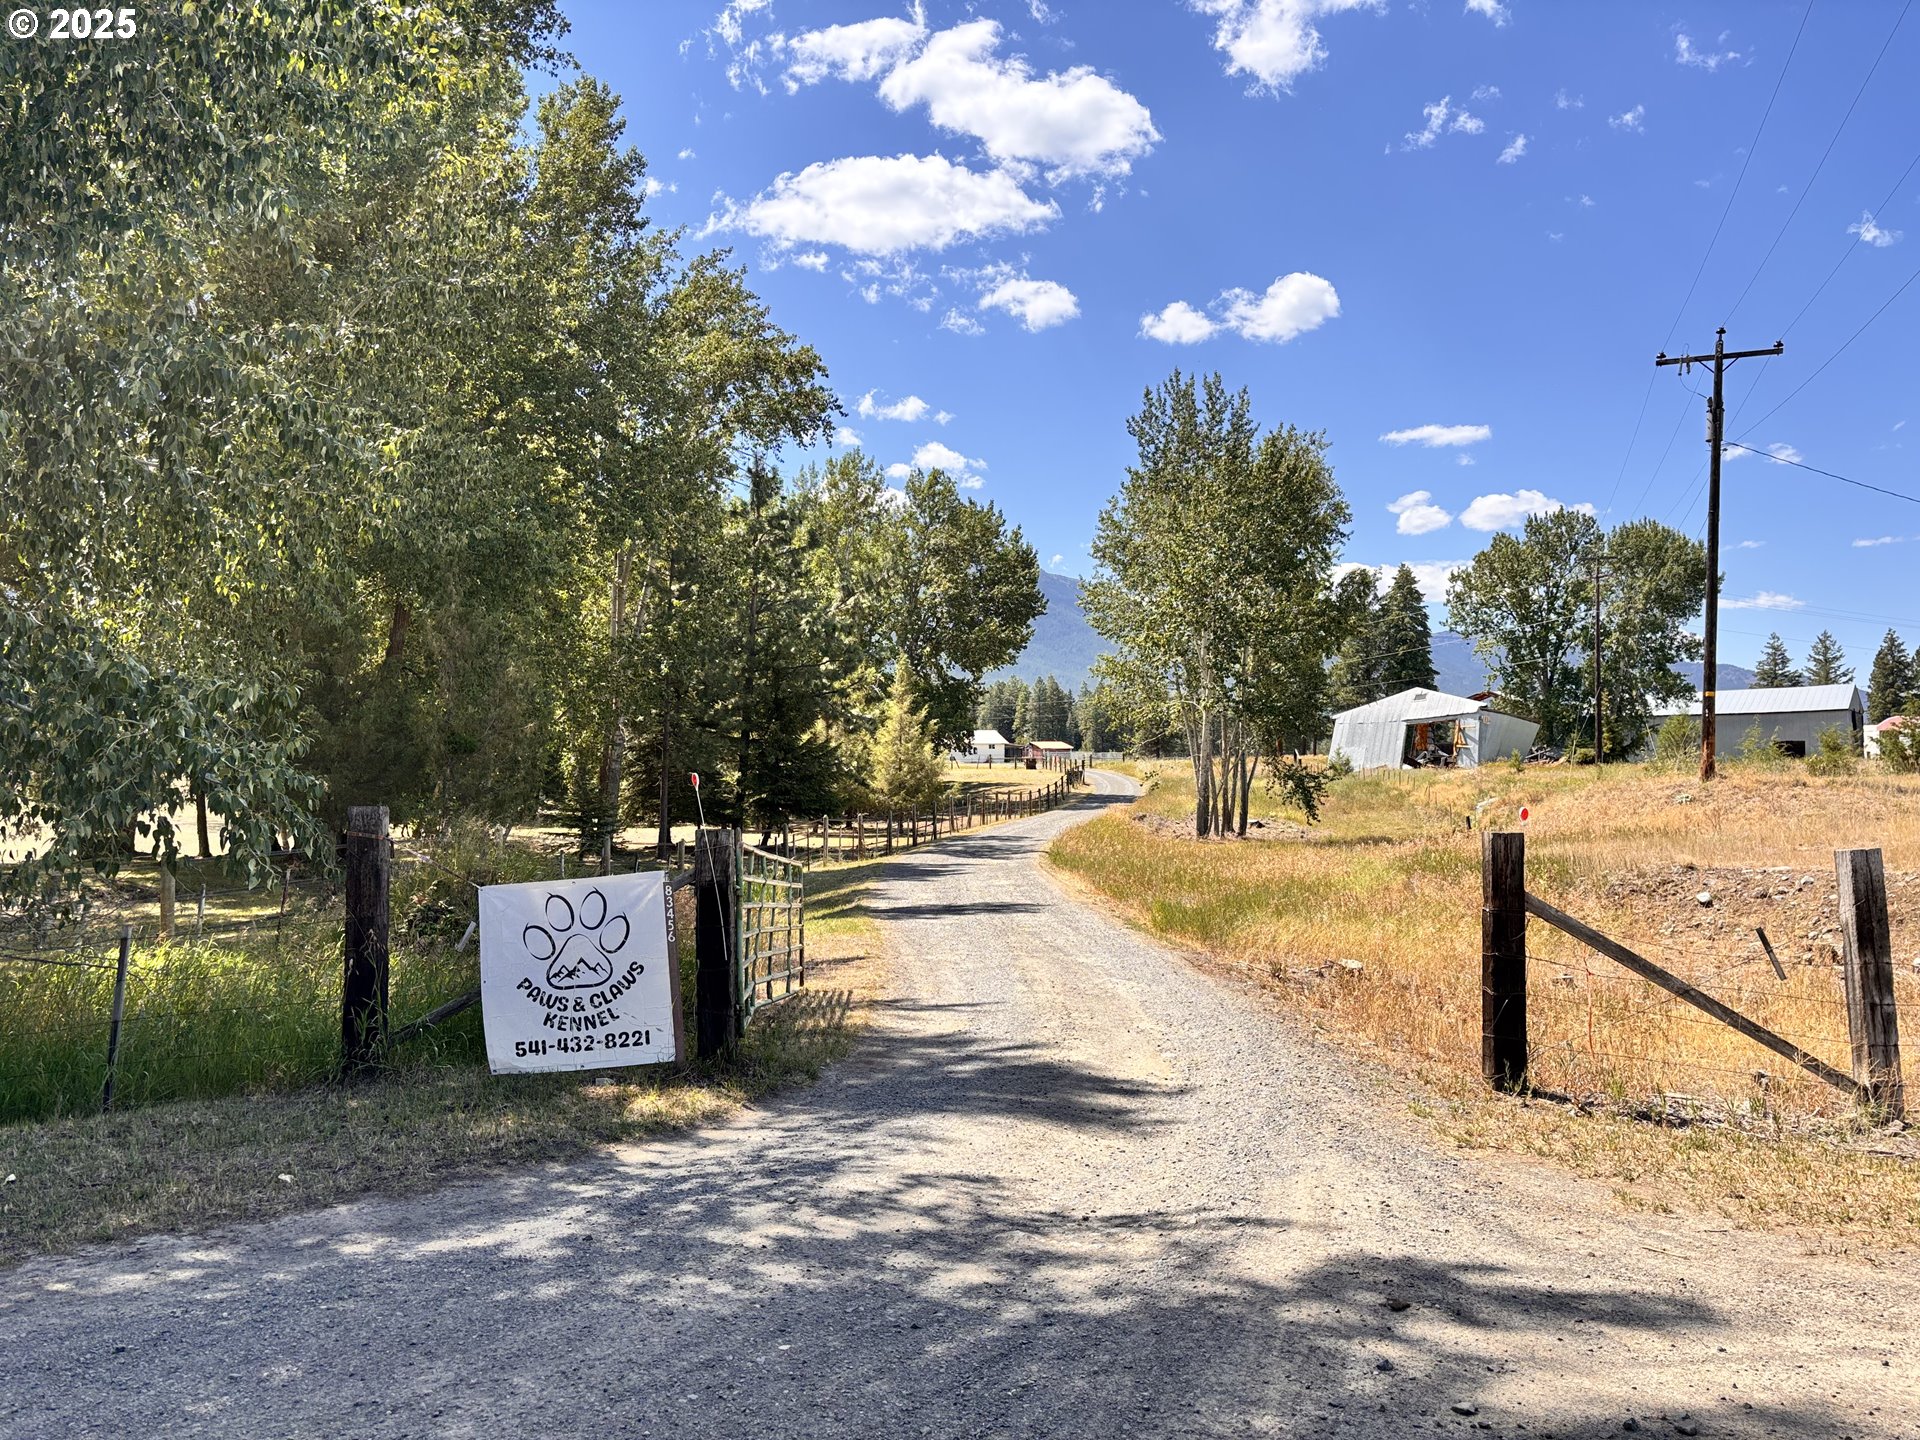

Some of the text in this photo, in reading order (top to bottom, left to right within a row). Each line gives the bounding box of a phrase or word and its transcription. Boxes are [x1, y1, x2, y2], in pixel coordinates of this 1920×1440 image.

[665, 885, 676, 942] 83456
[516, 961, 645, 1012] PAWS & CLAWS
[543, 1007, 620, 1031] KENNEL
[515, 1030, 651, 1057] 541-432-8221
